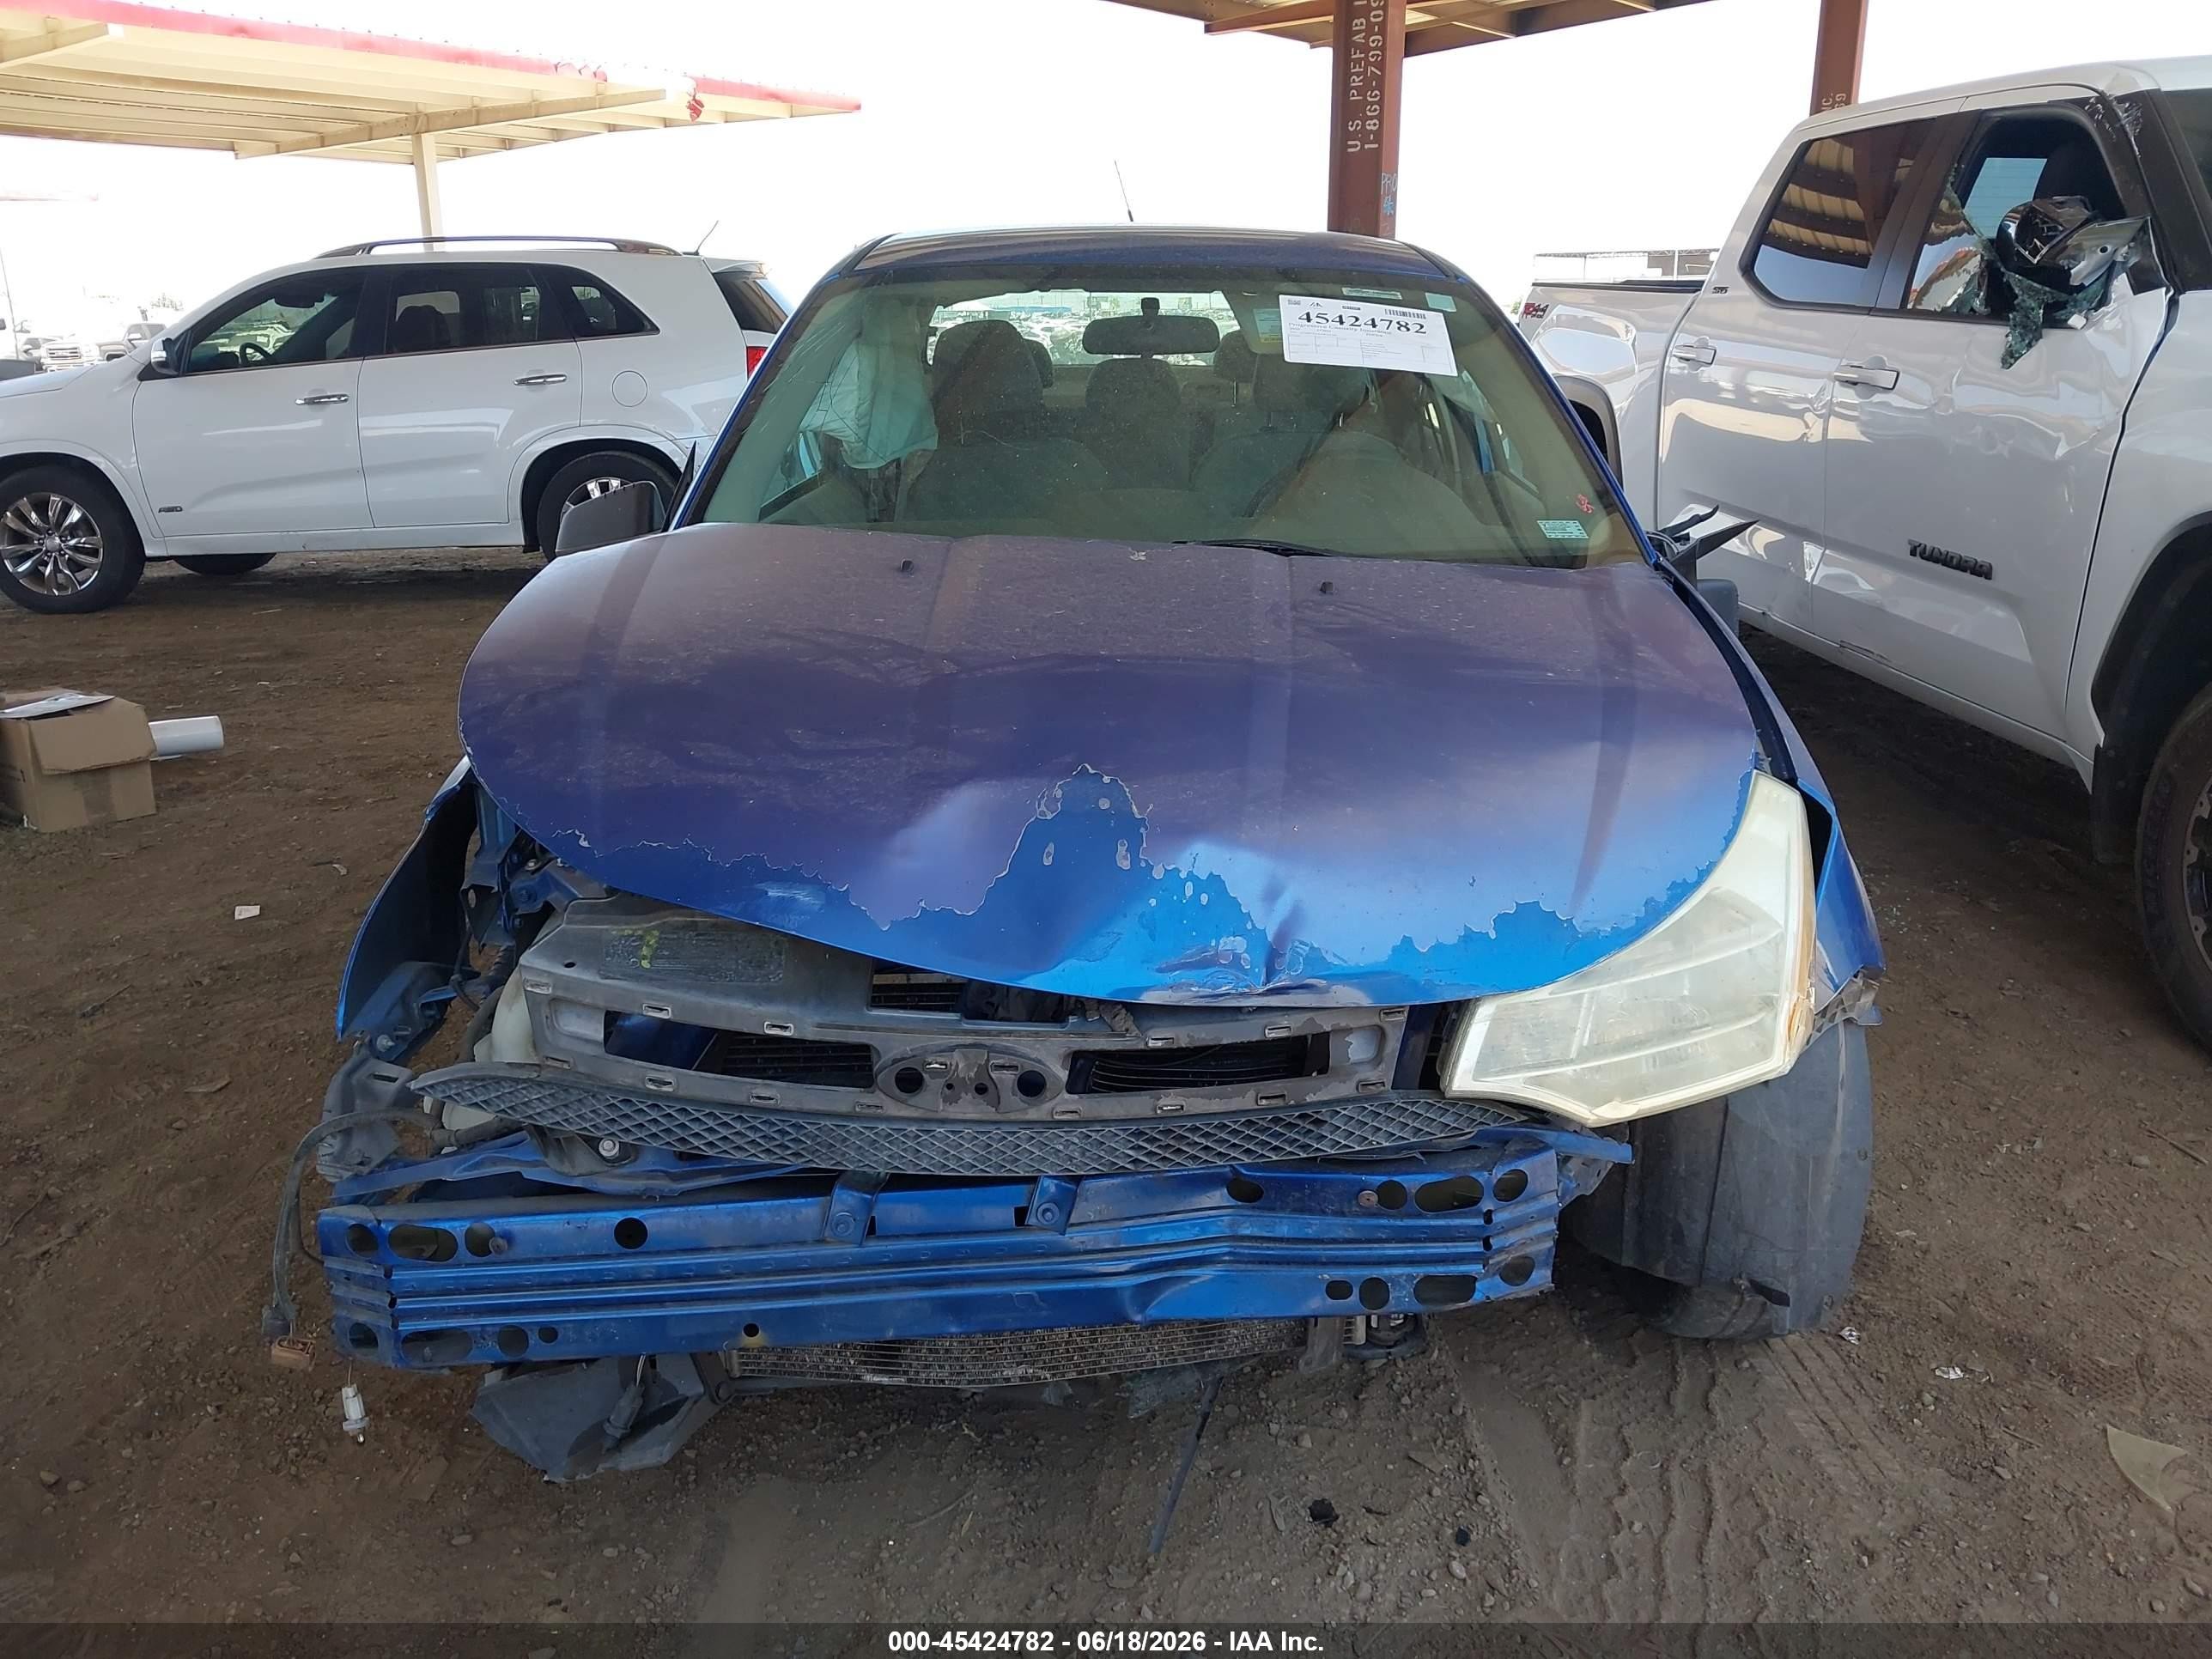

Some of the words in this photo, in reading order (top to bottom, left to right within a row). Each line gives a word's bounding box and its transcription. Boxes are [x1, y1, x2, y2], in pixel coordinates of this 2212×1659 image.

[1350, 17, 1366, 100] PREFAB
[1347, 113, 1362, 152] U.S.
[1297, 311, 1427, 335] 45424782
[1907, 538, 1993, 580] TUNDRA
